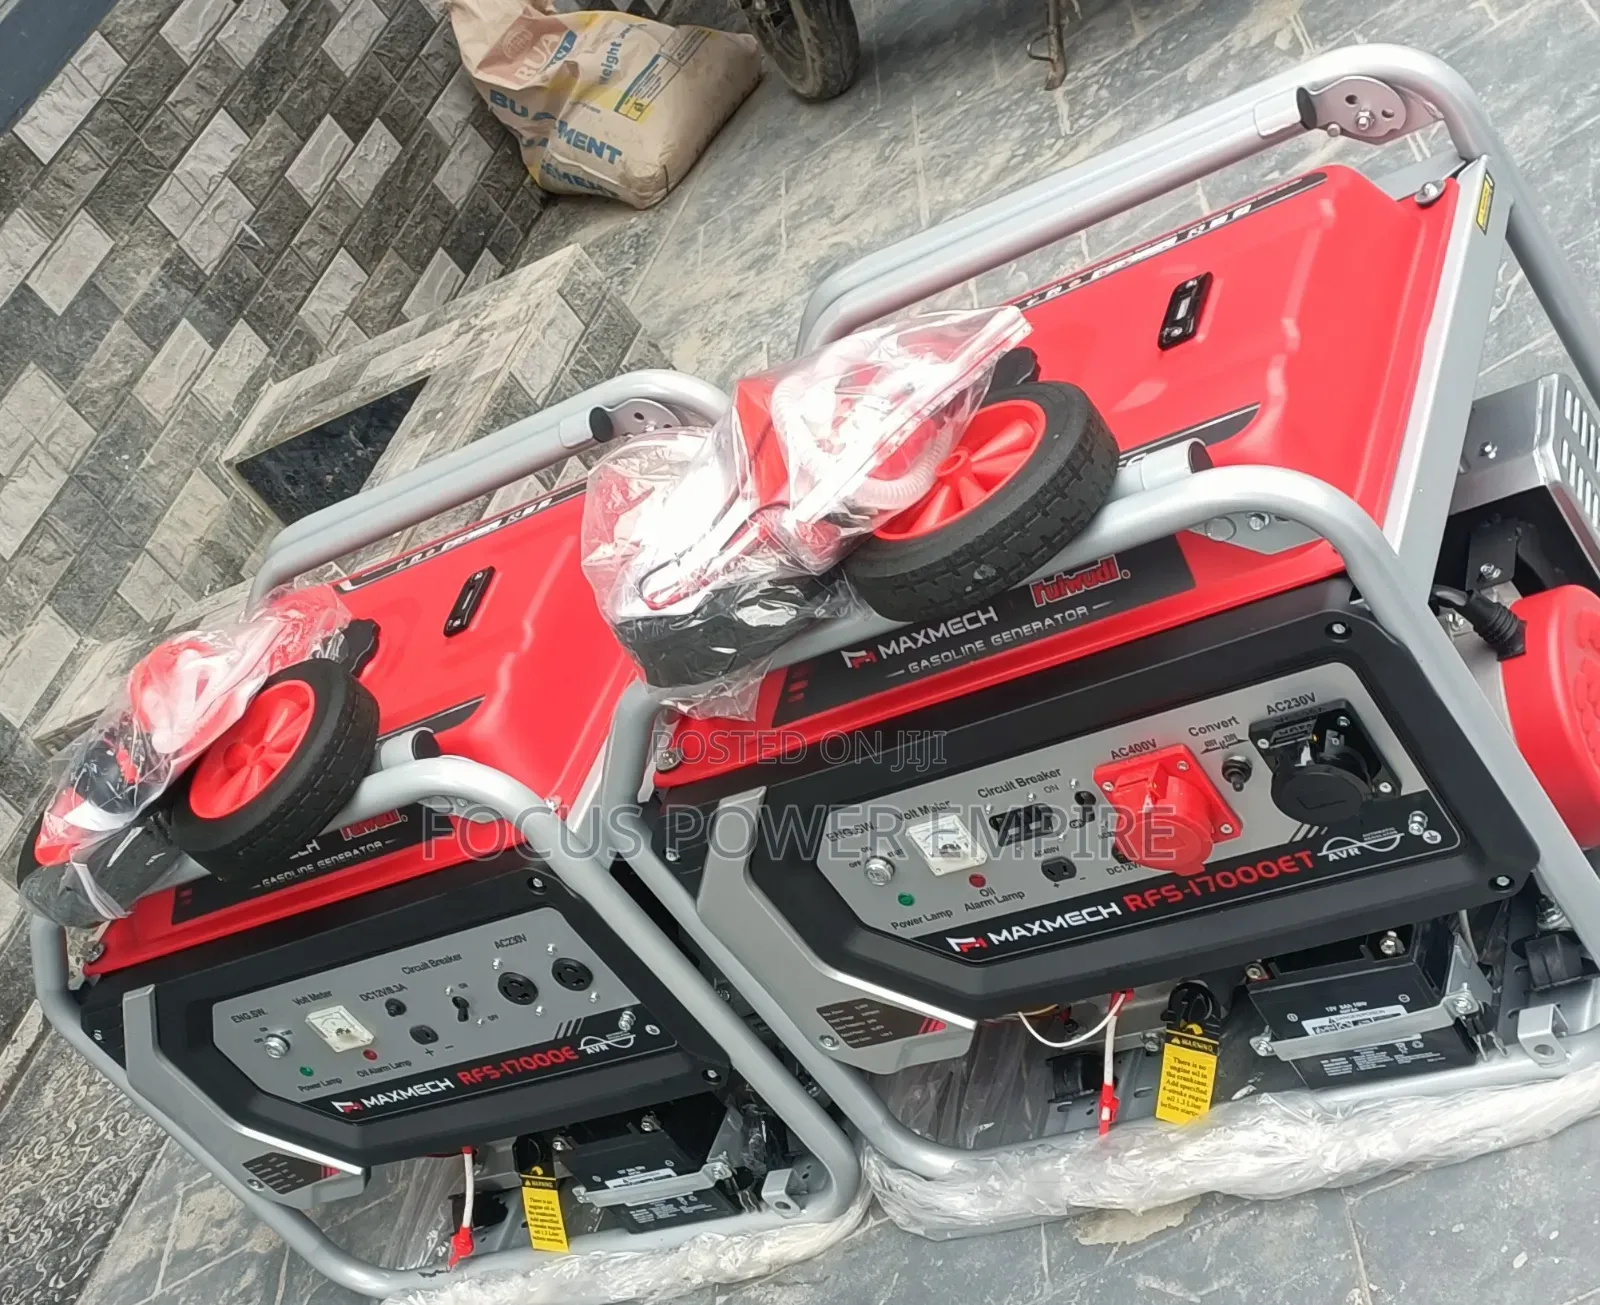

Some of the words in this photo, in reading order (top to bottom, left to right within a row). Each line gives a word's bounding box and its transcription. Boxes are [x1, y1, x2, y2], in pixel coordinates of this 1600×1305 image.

[515, 33, 562, 81] BUA
[878, 606, 999, 660] MAXMECH
[908, 640, 987, 675] GASOLINE
[991, 605, 1089, 647] GENERATOR
[1266, 691, 1317, 716] AC230V
[1187, 715, 1240, 737] Convert
[1110, 738, 1158, 761] AC400V
[977, 780, 1018, 799] Circuit
[1015, 767, 1063, 789] Breaker
[1043, 784, 1060, 795] ON
[262, 863, 315, 888] GASOLINE
[316, 840, 384, 868] GENERATOR
[1328, 847, 1361, 862] AVR
[964, 893, 995, 913] Alarm
[995, 889, 1026, 908] Lamp
[979, 887, 996, 899] Oil
[988, 901, 1122, 946] MAXMECH
[1123, 851, 1314, 913] RFS-17000ET
[890, 915, 923, 931] Power
[922, 908, 954, 925] Lamp
[401, 959, 431, 975] Circuit
[429, 952, 463, 968] Breaker
[292, 994, 311, 1006] Volt
[309, 989, 333, 1003] Meter
[1181, 1038, 1213, 1052] WARNING
[391, 1058, 412, 1071] Lamp
[1173, 1056, 1190, 1067] There
[298, 1080, 321, 1093] Power
[320, 1076, 343, 1088] Lamp
[360, 1077, 455, 1108] MAXMECH
[457, 1046, 579, 1086] RFS-17000E
[1166, 1079, 1179, 1087] Add
